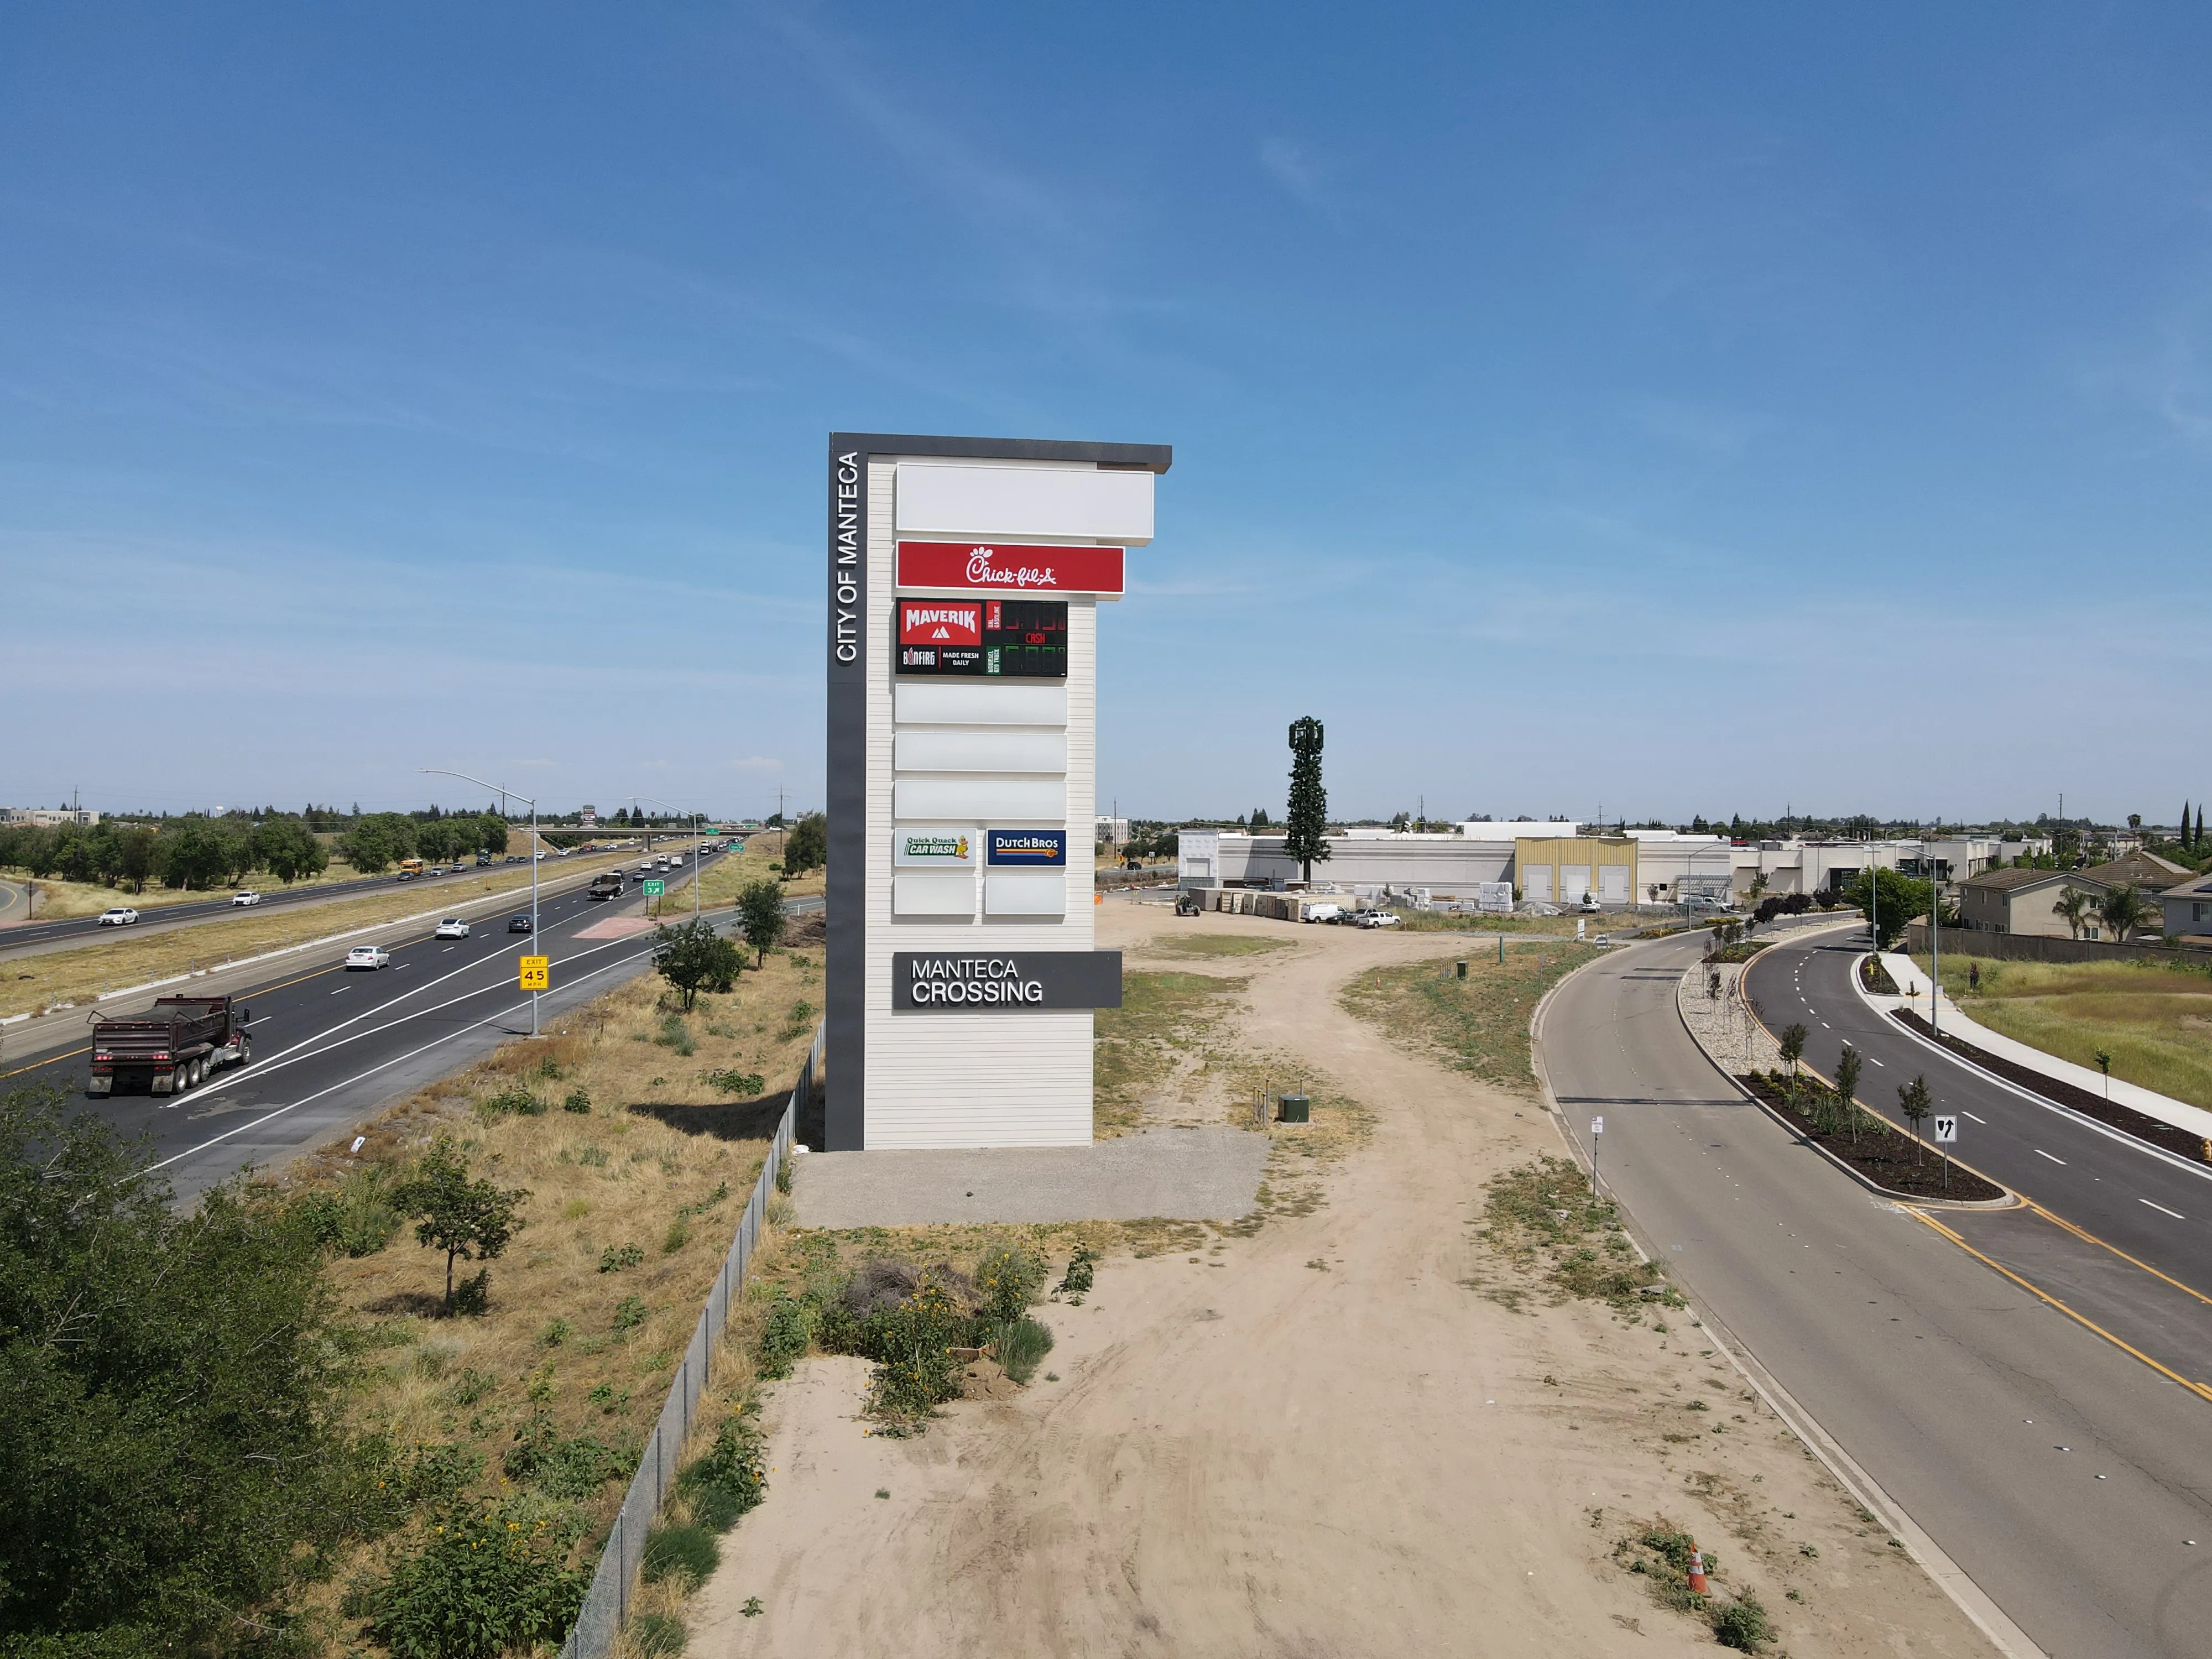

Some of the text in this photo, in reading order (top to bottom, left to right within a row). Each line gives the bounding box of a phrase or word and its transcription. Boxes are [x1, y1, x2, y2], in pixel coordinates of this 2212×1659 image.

[837, 451, 858, 661] CITY OF MANTECA
[966, 554, 1057, 587] Chick-fil-A
[906, 609, 976, 634] MAVERIK
[1026, 633, 1045, 644] CASH
[903, 647, 935, 665] BONFIRE
[910, 845, 956, 854] CAR WASH
[1031, 838, 1058, 848] BROS
[524, 971, 544, 980] 45
[912, 959, 1019, 978] MANTECA
[912, 981, 1042, 1002] CROSSING
